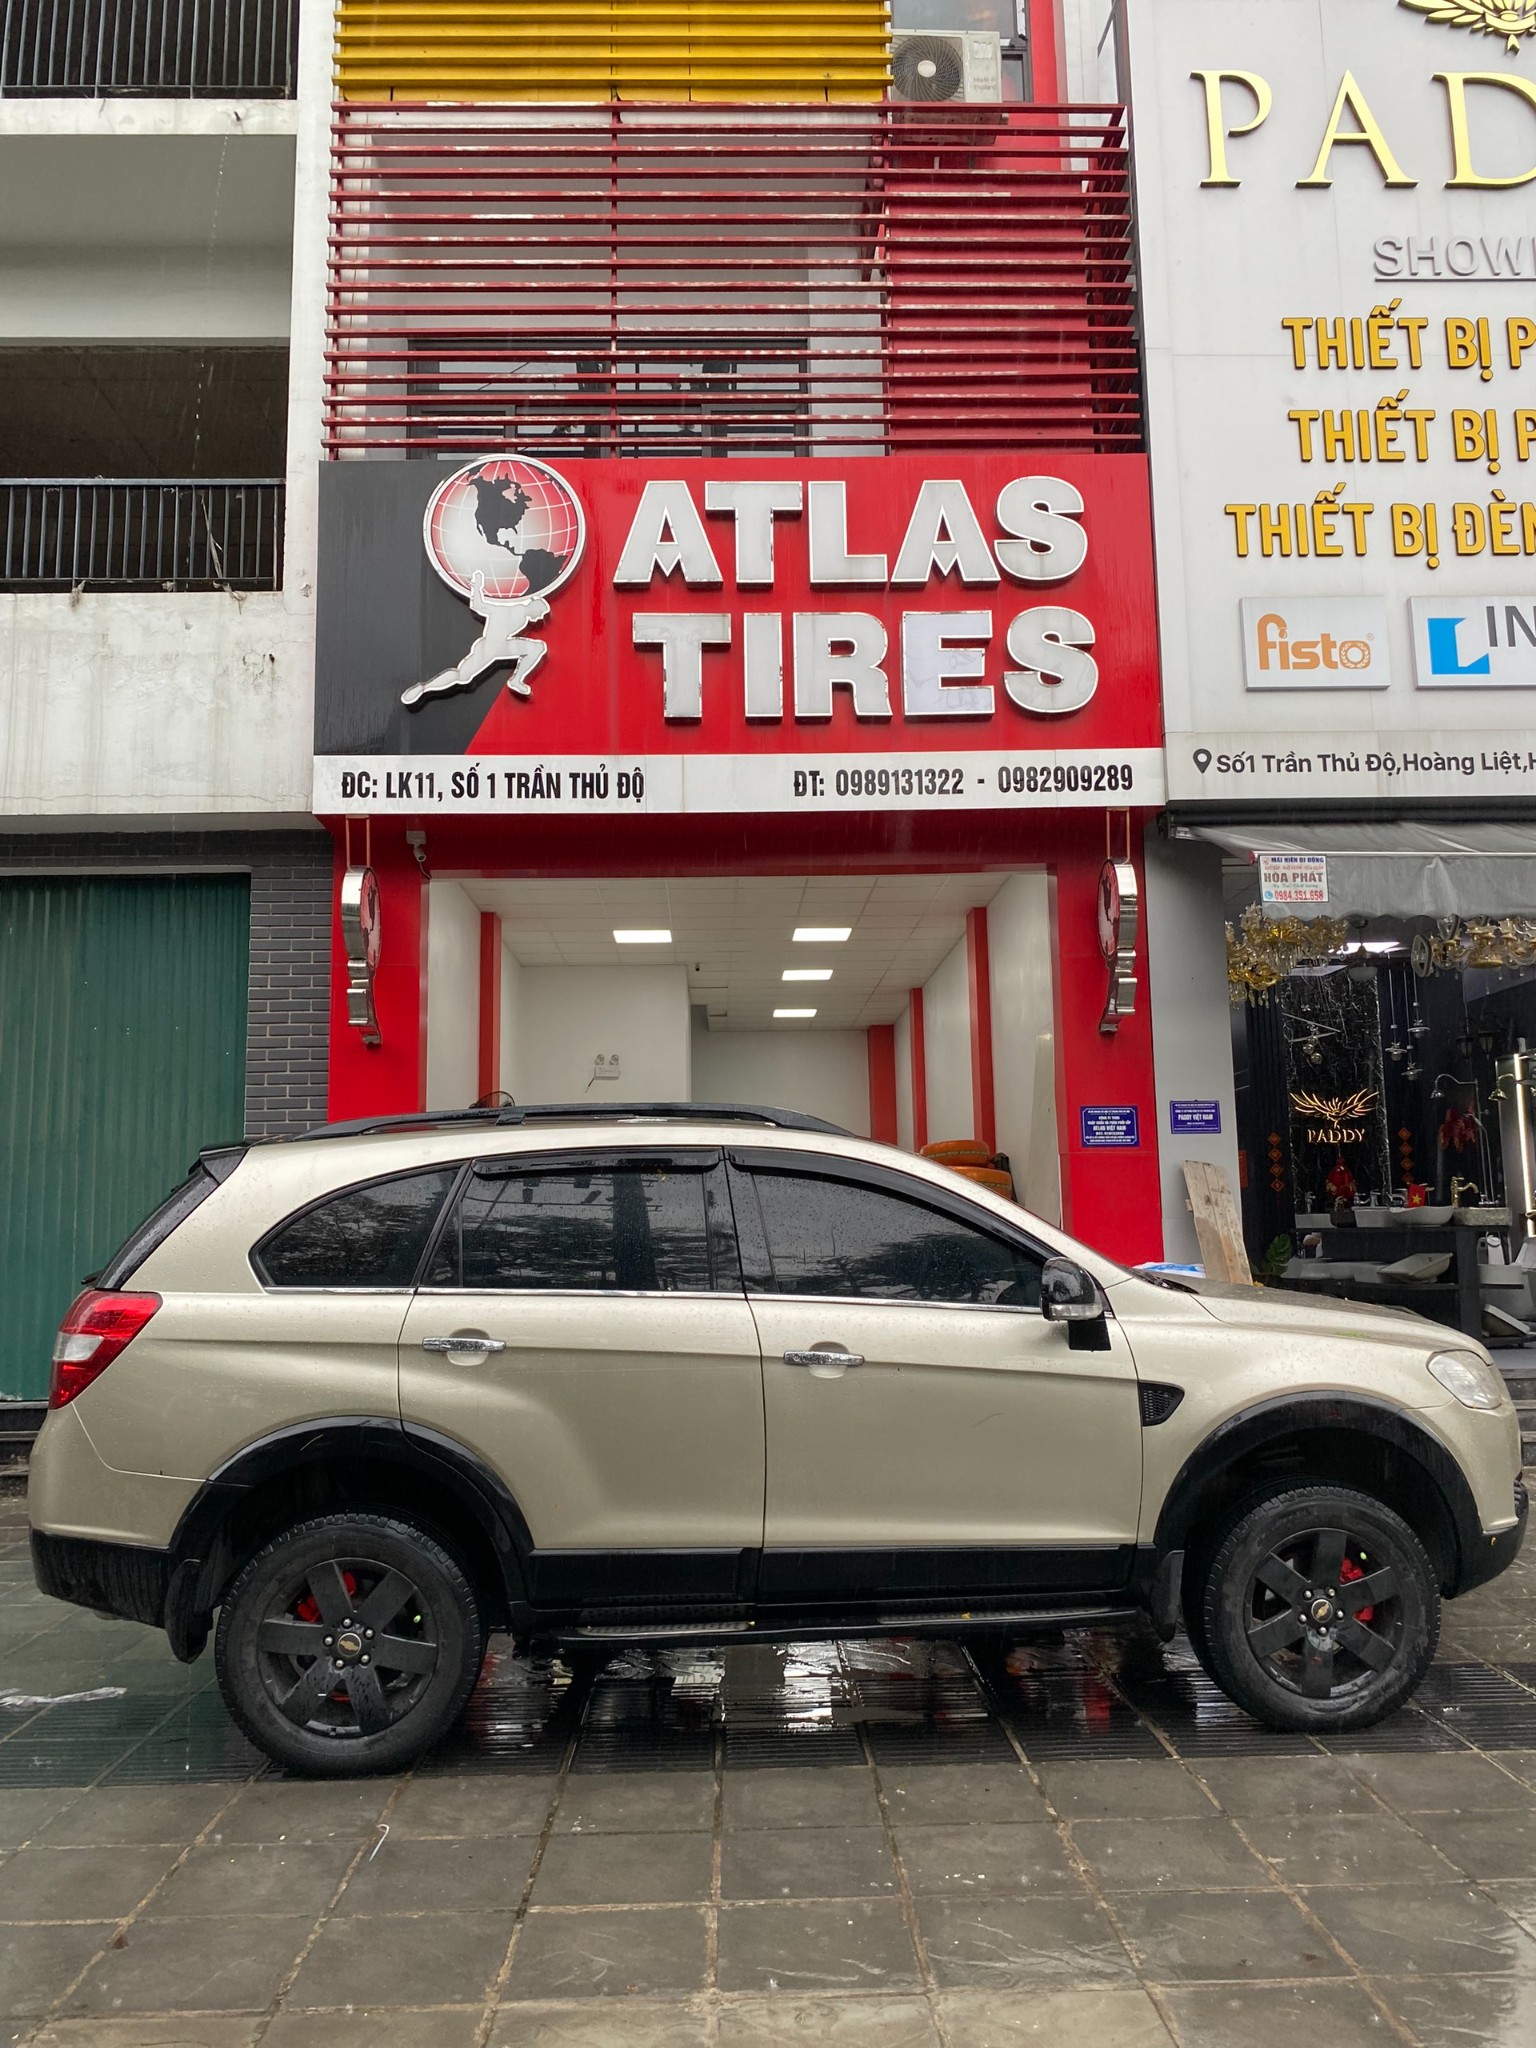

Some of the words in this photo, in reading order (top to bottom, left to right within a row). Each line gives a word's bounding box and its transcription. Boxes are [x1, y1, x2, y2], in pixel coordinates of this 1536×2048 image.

[1374, 235, 1536, 277] SHOW
[1282, 298, 1429, 370] THIẾT
[1445, 317, 1494, 381] BỊ
[1507, 317, 1536, 370] P
[1288, 389, 1436, 463] THIẾT
[1452, 409, 1502, 473] BỊ
[613, 475, 1089, 589] ATLAS
[1224, 482, 1375, 557] THIẾT
[1391, 503, 1440, 568] BỊ
[632, 606, 1099, 723] TIRES
[1257, 613, 1372, 671] fisto
[341, 771, 378, 799] ĐC:
[385, 772, 443, 803] LK11,
[451, 762, 480, 799] SỐ
[486, 773, 496, 799] 1
[504, 764, 561, 799] TRẦN
[569, 763, 609, 799] THỦ
[617, 766, 644, 804] ĐỘ
[793, 770, 825, 797] ĐT:
[835, 768, 964, 797] 0989131322
[998, 764, 1133, 794] 0982909289
[1216, 751, 1256, 774] Số1
[1262, 751, 1313, 773] Trần
[1317, 752, 1360, 772] Thủ
[1264, 871, 1288, 882] HÒA
[1292, 871, 1323, 882] PHÁT
[1307, 1128, 1365, 1143] PADDY
